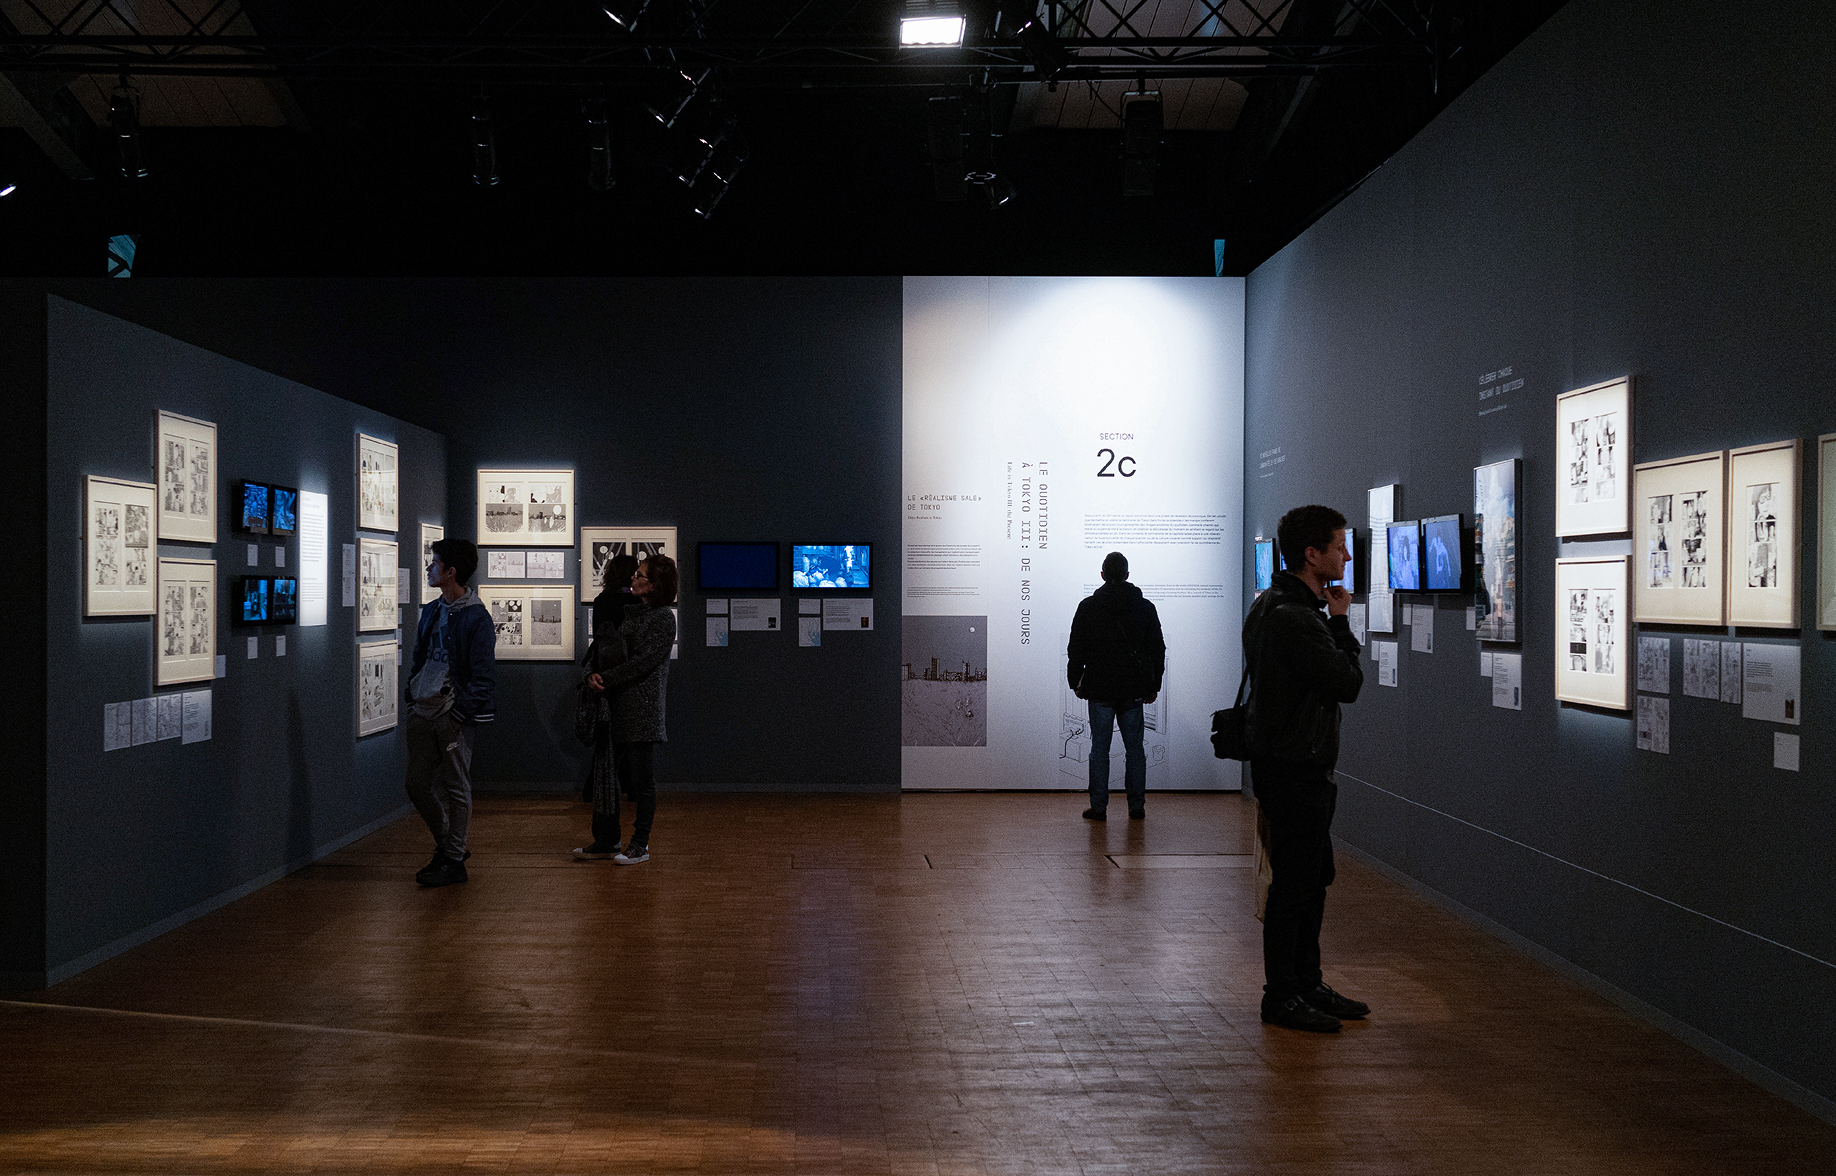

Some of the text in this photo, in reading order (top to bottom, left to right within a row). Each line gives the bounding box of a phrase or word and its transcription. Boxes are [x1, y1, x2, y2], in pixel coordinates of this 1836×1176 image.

[1099, 432, 1134, 441] SECTION
[1096, 448, 1136, 478] 2c
[907, 503, 941, 511] DE TOKYO
[1022, 476, 1031, 513] TOKYO
[1039, 461, 1048, 550] LE QUOTIDIEN
[1022, 558, 1031, 572] DE
[1022, 579, 1031, 601] NOS
[1022, 608, 1031, 645] JOURS
